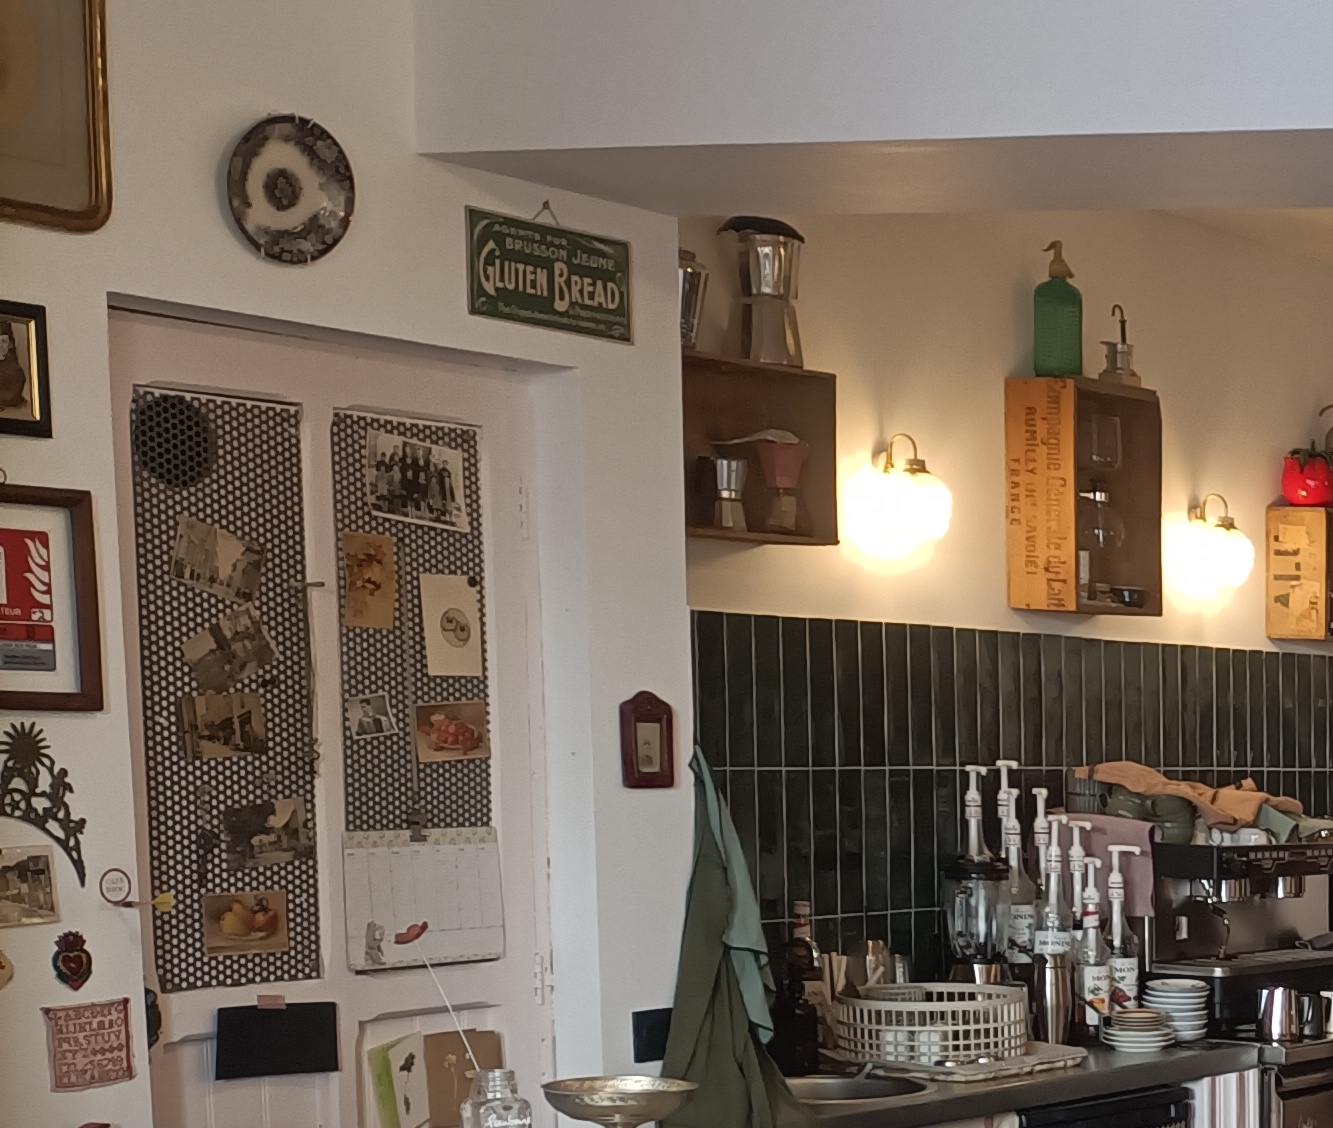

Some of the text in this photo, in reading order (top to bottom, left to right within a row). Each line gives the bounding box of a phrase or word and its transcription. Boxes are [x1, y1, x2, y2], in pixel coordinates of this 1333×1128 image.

[478, 238, 620, 312] GLUTEN BREAD
[505, 237, 567, 261] BRUSSON
[1010, 457, 1021, 526] FRANCE
